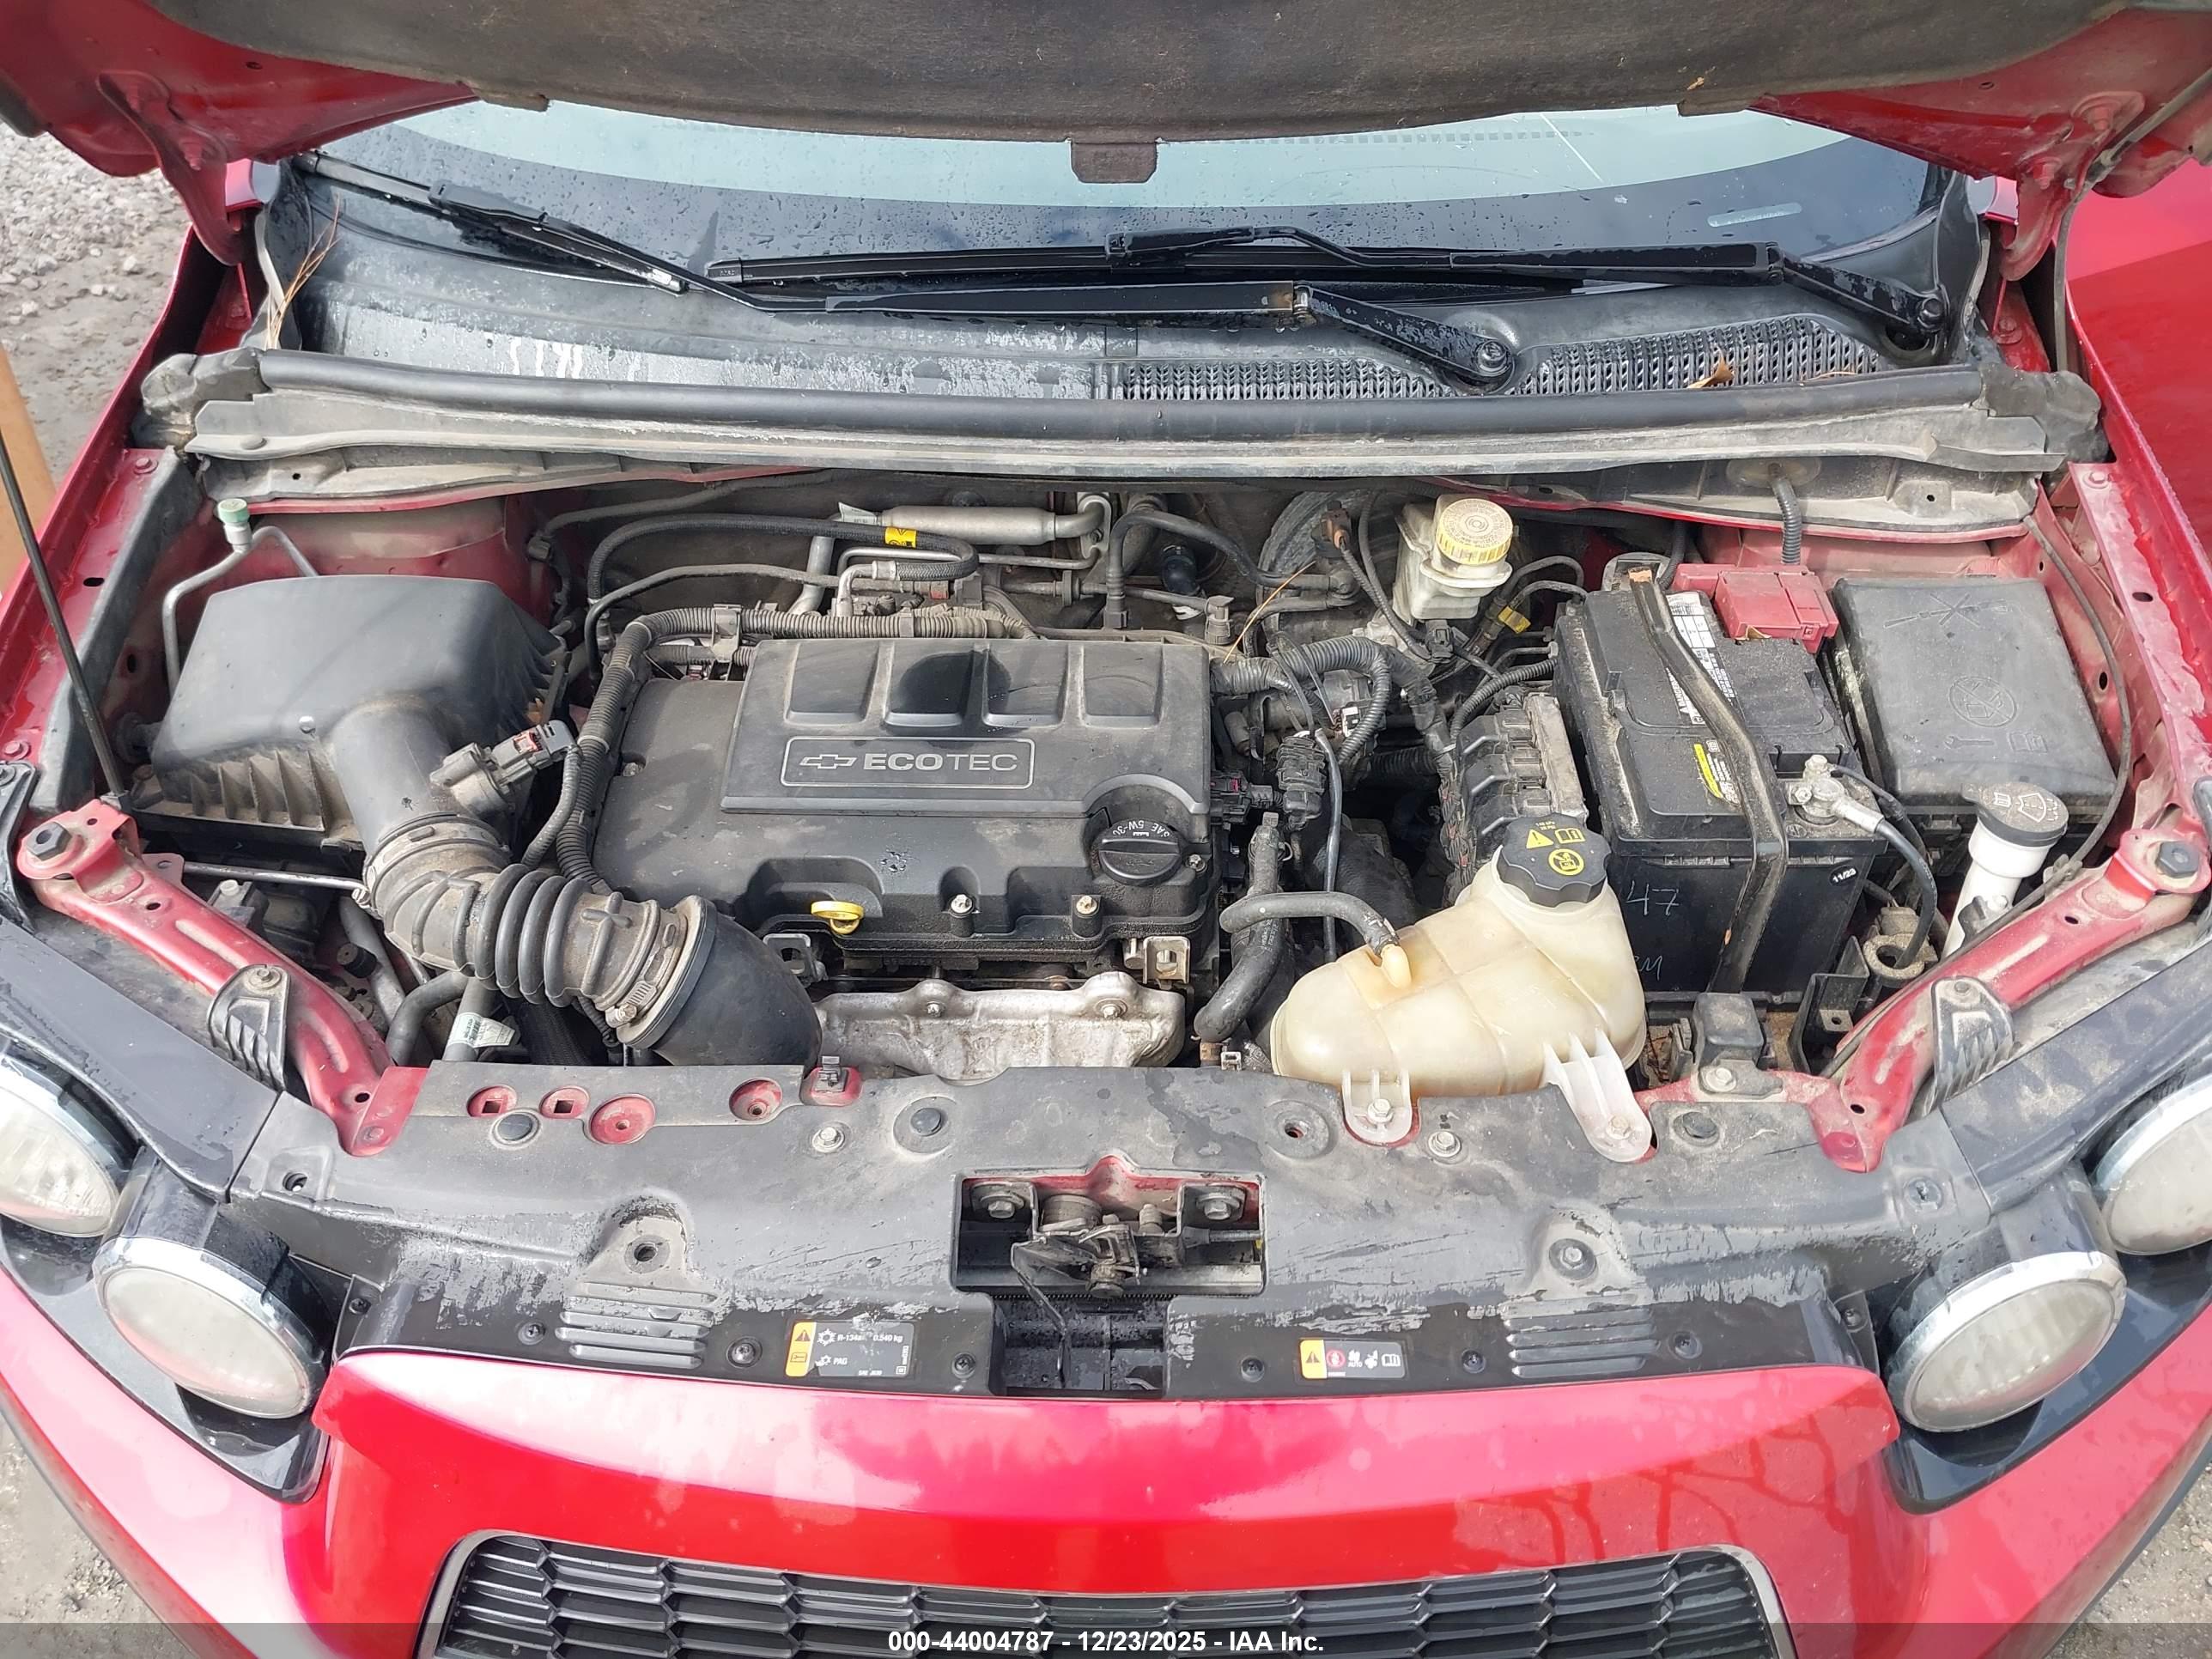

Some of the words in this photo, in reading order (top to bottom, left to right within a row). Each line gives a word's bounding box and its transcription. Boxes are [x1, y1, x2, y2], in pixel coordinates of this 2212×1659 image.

[863, 753, 1018, 771] ECOTEC
[1150, 823, 1170, 838] SAE
[1626, 880, 1680, 916] 47
[893, 1334, 903, 1343] kg
[833, 1357, 848, 1365] PAG
